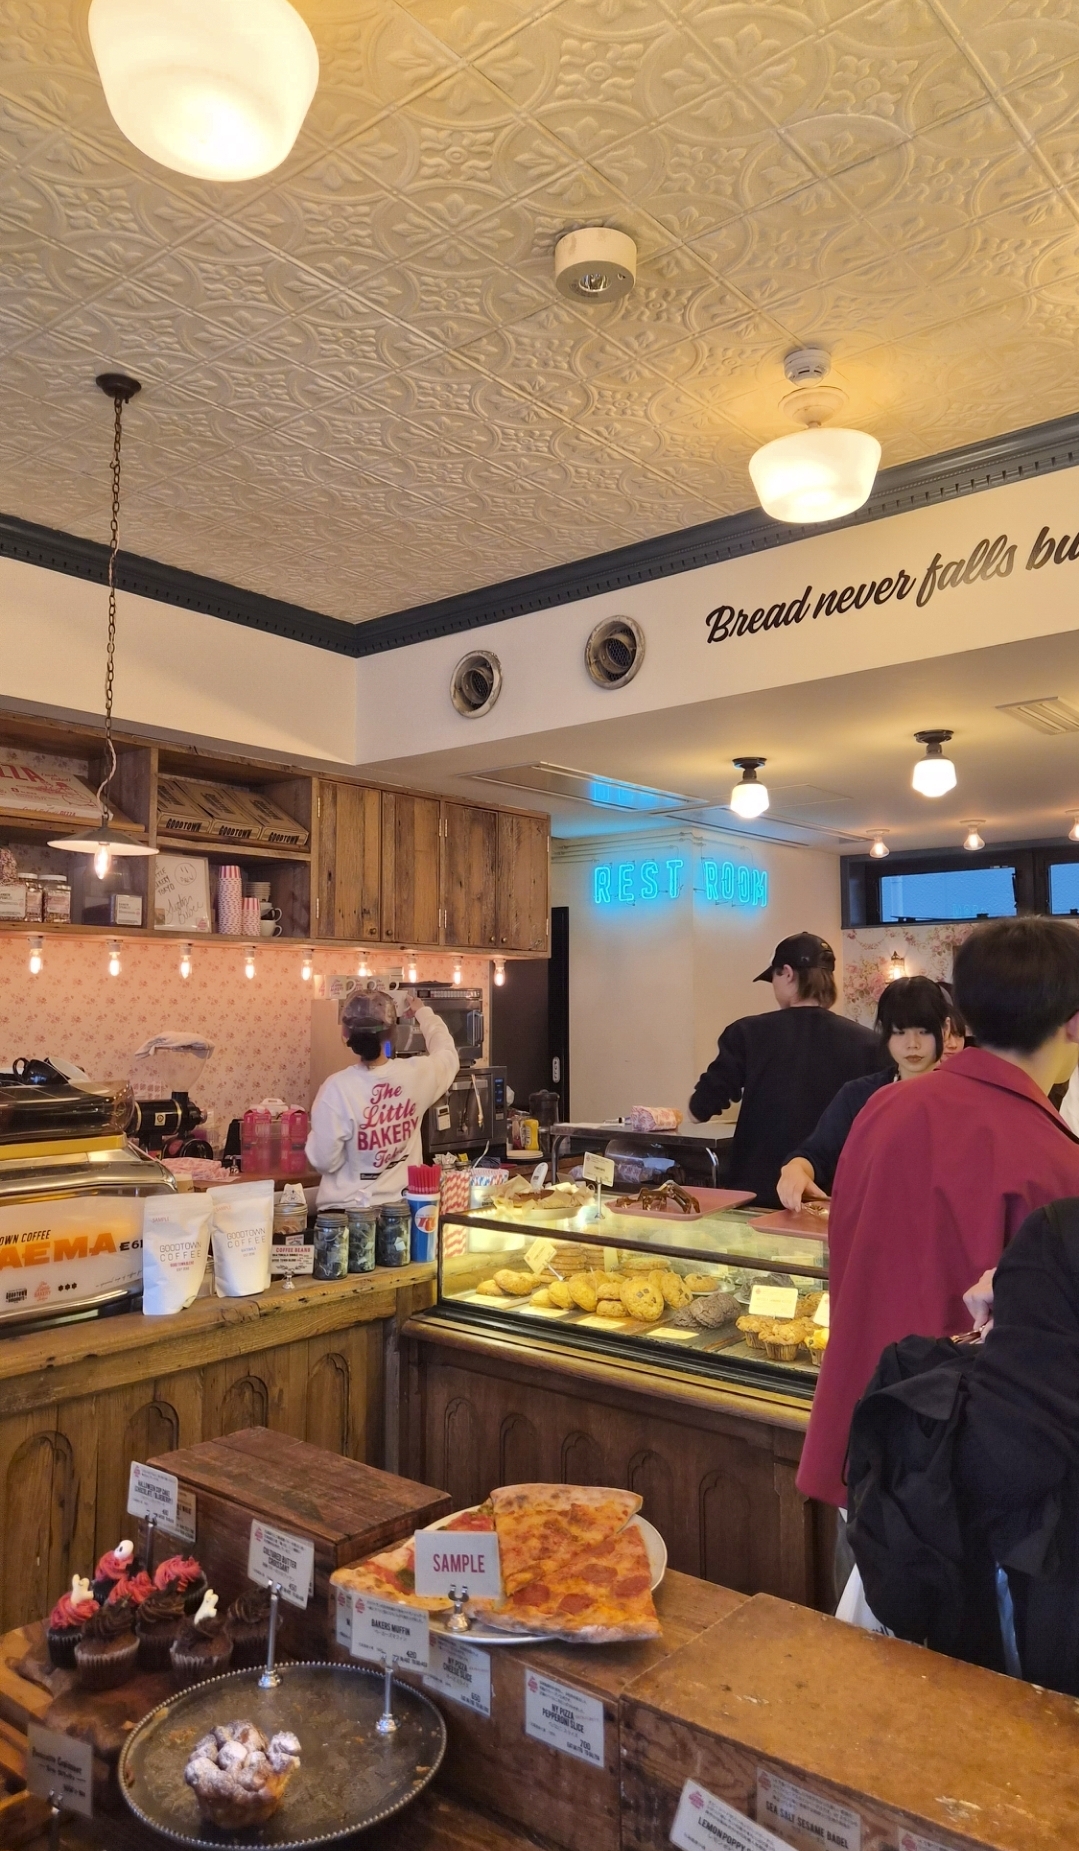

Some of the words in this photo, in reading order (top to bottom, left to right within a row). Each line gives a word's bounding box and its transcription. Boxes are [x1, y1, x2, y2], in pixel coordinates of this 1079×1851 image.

[706, 586, 812, 643] Bread
[812, 569, 916, 619] never
[916, 534, 1018, 608] falls
[166, 818, 202, 832] GOODTOWN
[218, 825, 253, 838] GOODTOWN
[268, 832, 300, 845] GOODTOWN
[594, 859, 683, 904] REST
[703, 861, 768, 908] ROOM
[370, 1083, 402, 1105] The
[360, 1098, 416, 1129] Little
[357, 1116, 419, 1151] BAKERY
[21, 1230, 51, 1243] COFFEE
[227, 1227, 266, 1240] GOODTOWN
[227, 1236, 266, 1248] COFFEE
[160, 1241, 201, 1253] GOODTOWN
[160, 1249, 201, 1263] COFFEE
[263, 1546, 281, 1561] CULTURED
[281, 1555, 297, 1569] BUTTER
[268, 1556, 290, 1573] CROISSANT
[433, 1553, 485, 1573] SAMPLE
[371, 1618, 390, 1630] BAKERS
[391, 1624, 411, 1636] MUFFIN
[551, 1703, 559, 1713] NY
[559, 1707, 574, 1720] PIZZA
[542, 1707, 569, 1727] PEPPERONI
[570, 1720, 584, 1734] SLICE
[580, 1739, 591, 1750] 700
[766, 1800, 778, 1815] SEA
[780, 1808, 795, 1823] SALT
[797, 1816, 825, 1838] SESAME
[826, 1830, 849, 1850] BAGEL
